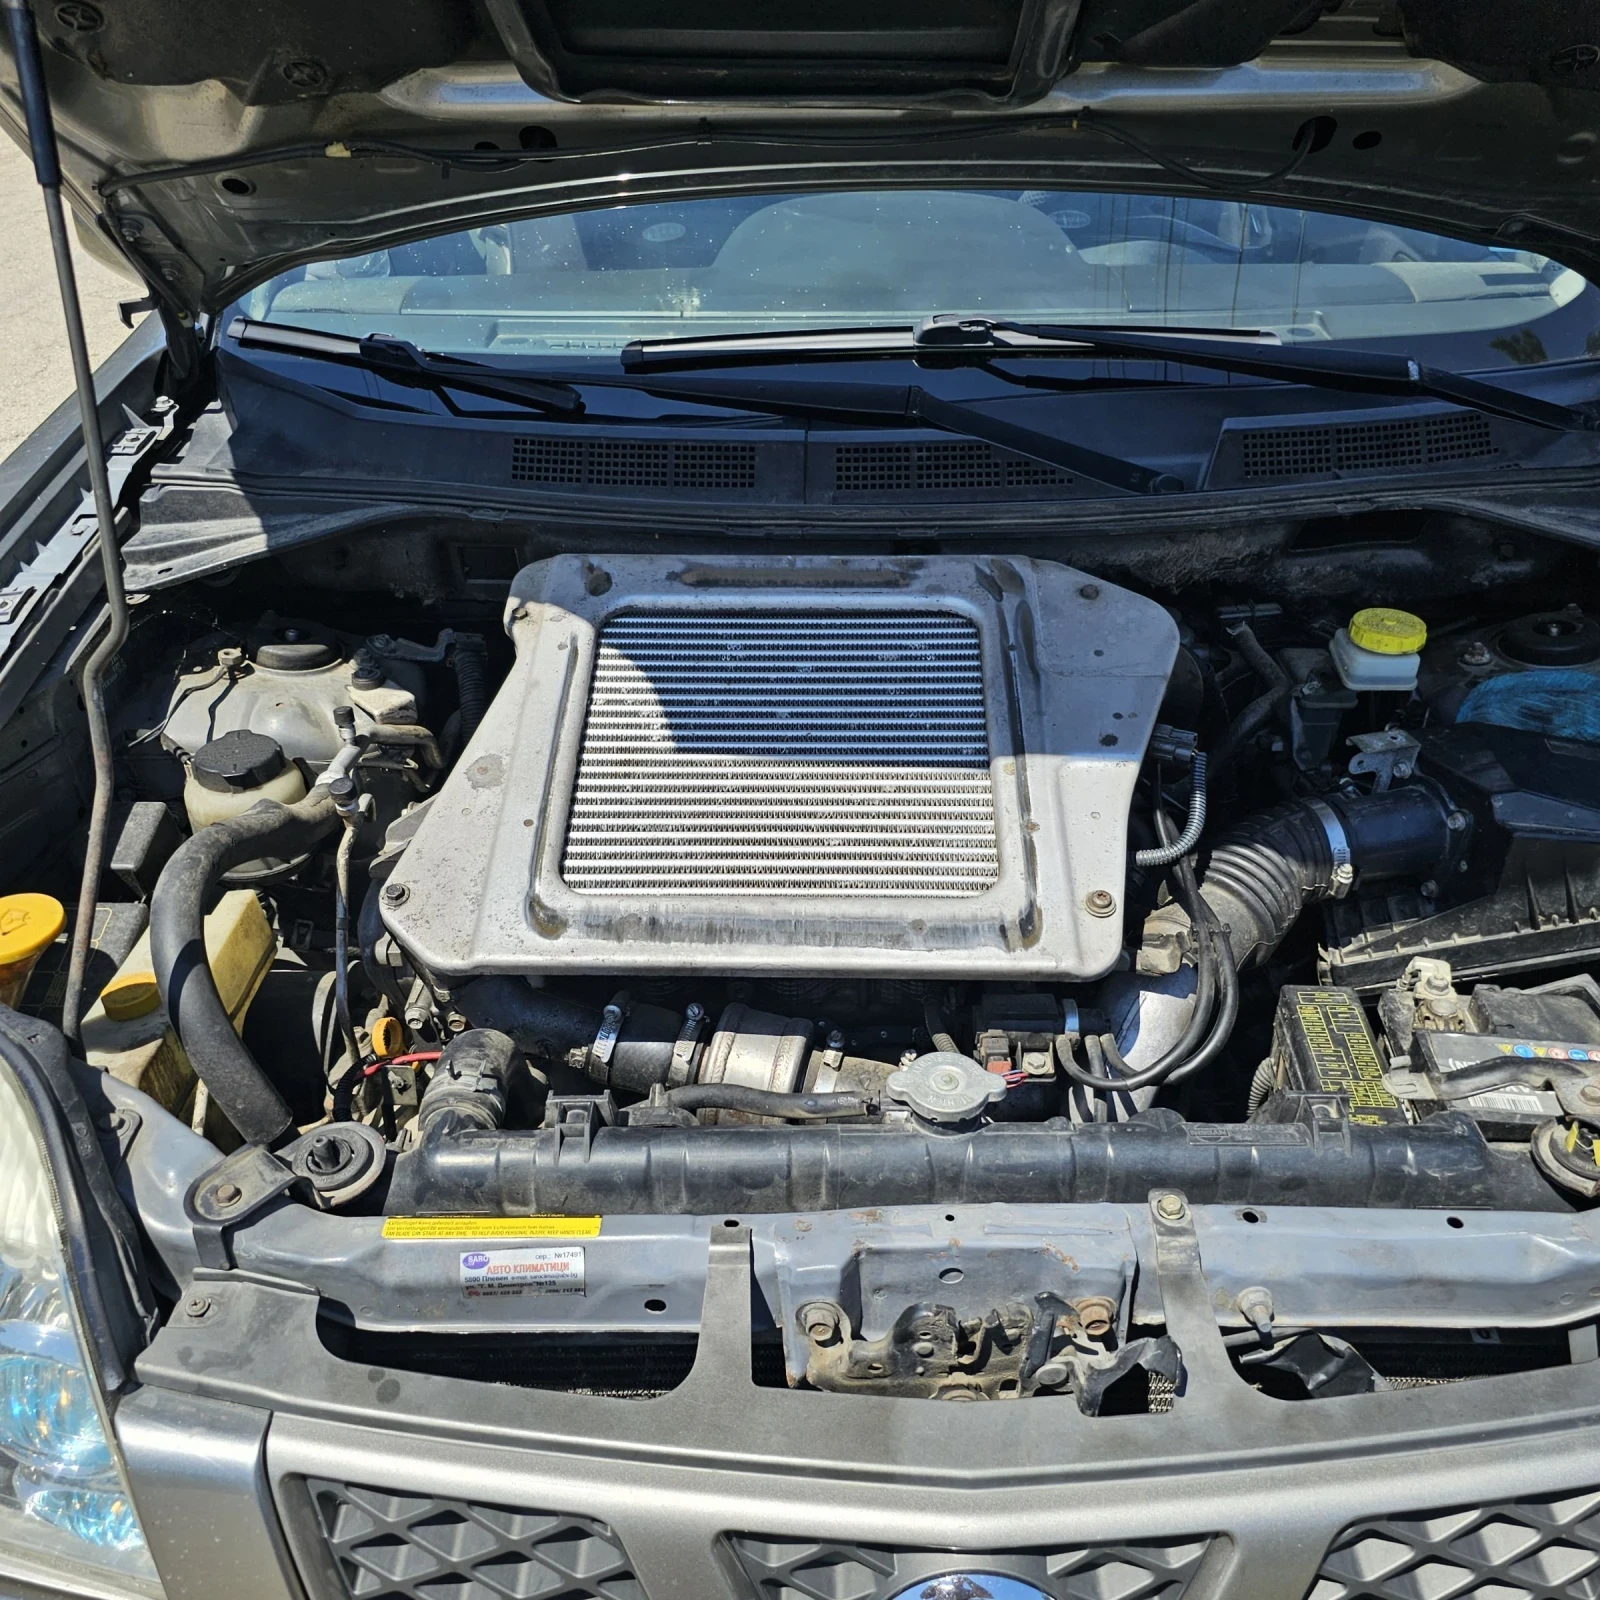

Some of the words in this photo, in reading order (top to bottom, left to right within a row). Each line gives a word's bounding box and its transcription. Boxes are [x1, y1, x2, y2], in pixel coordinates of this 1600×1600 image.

[468, 1254, 488, 1264] SARO
[554, 1251, 582, 1259] №17491
[486, 1265, 511, 1275] АВТО
[513, 1261, 570, 1274] КЛИМАТИЦИ
